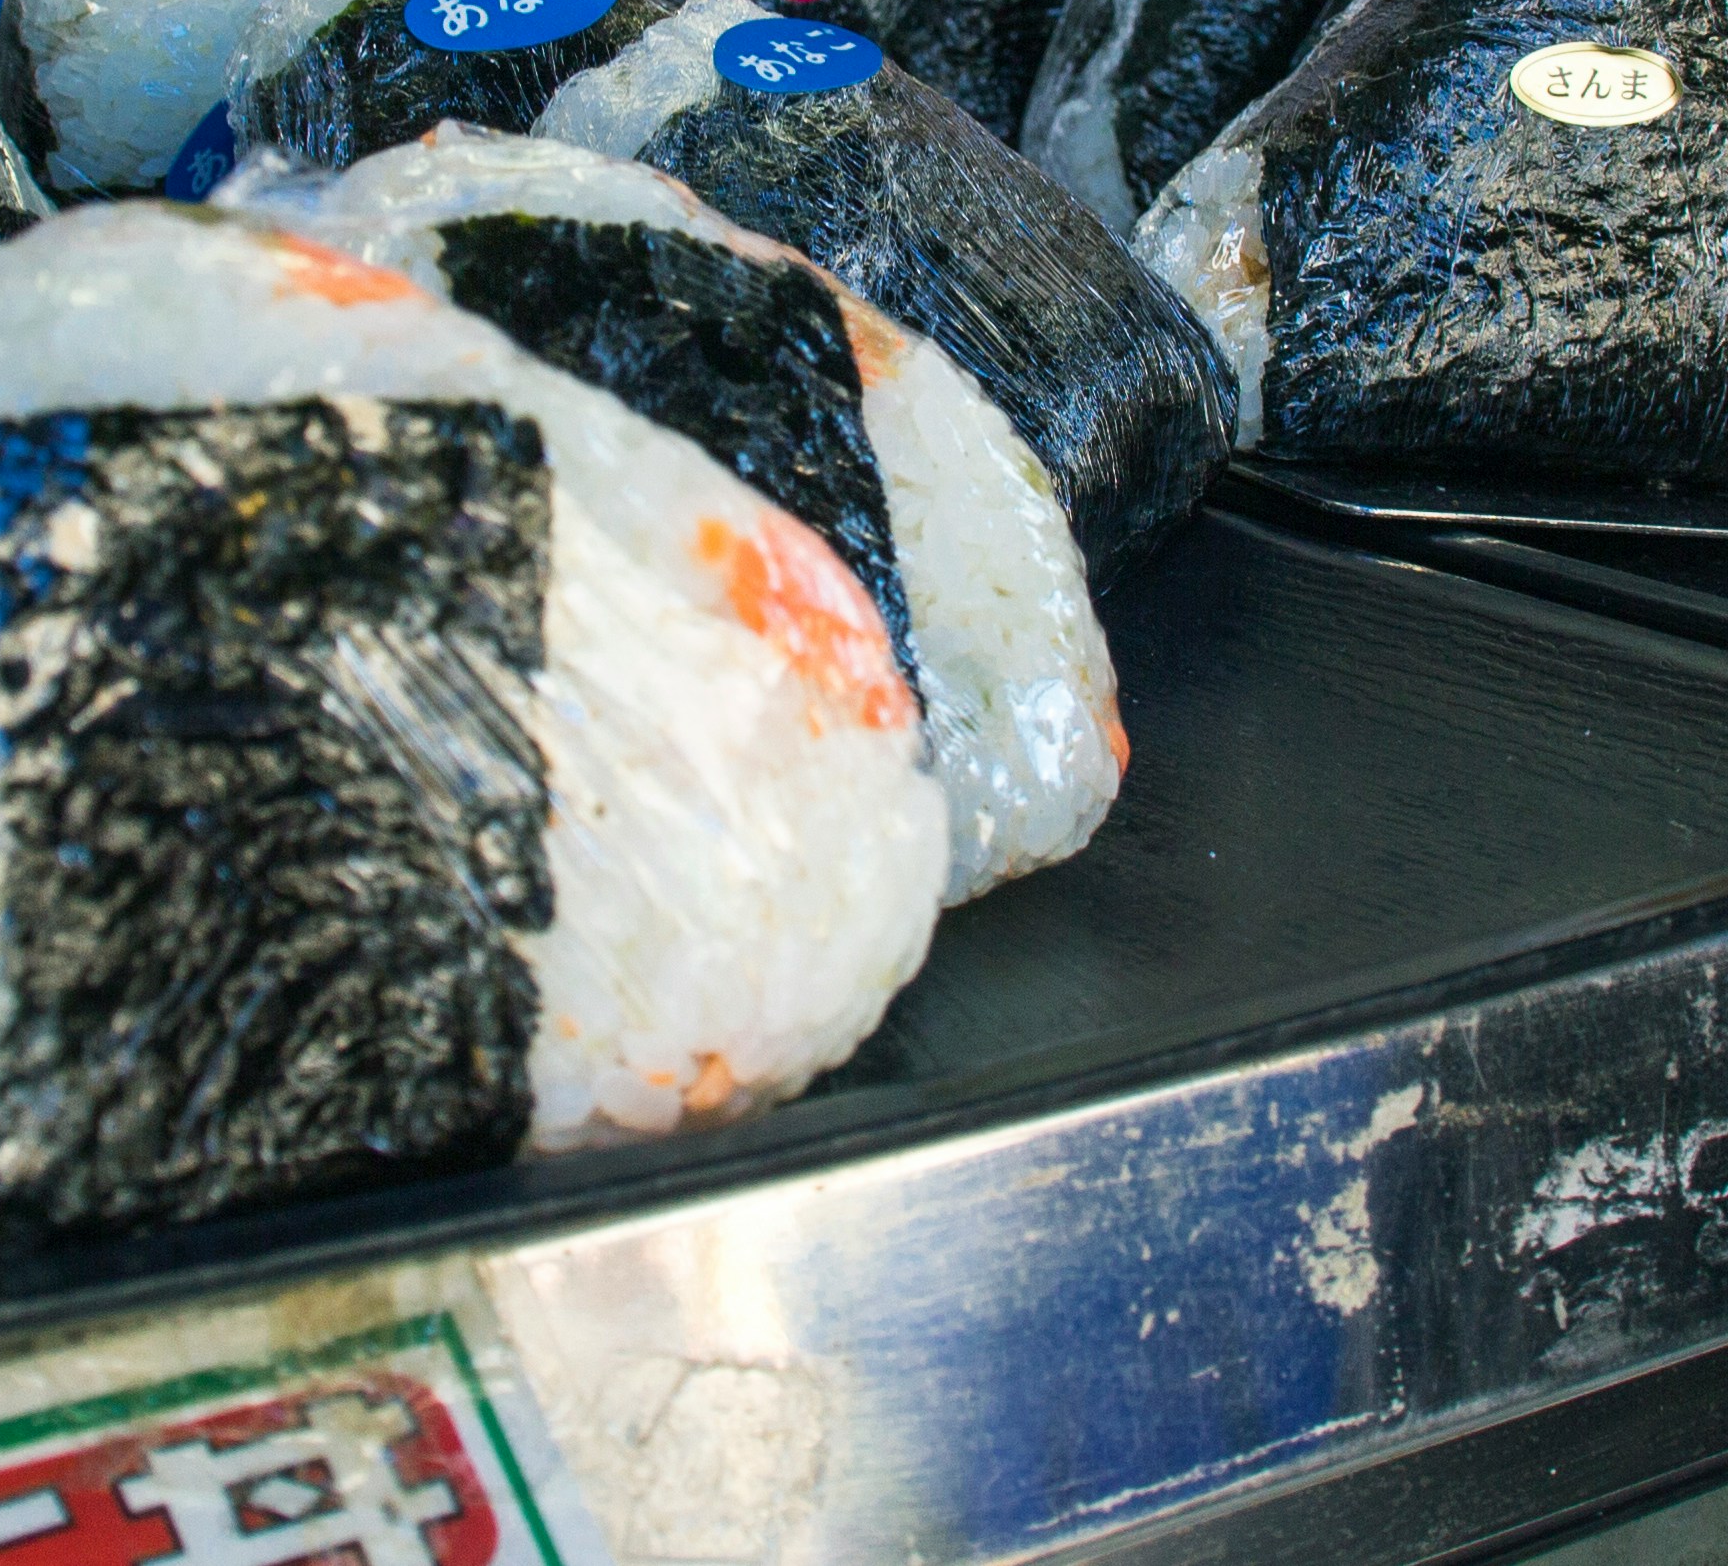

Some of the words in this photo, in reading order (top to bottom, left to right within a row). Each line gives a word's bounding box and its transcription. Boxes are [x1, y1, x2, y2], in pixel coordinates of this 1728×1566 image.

[736, 27, 860, 84] あなご
[1544, 62, 1650, 104] さんま
